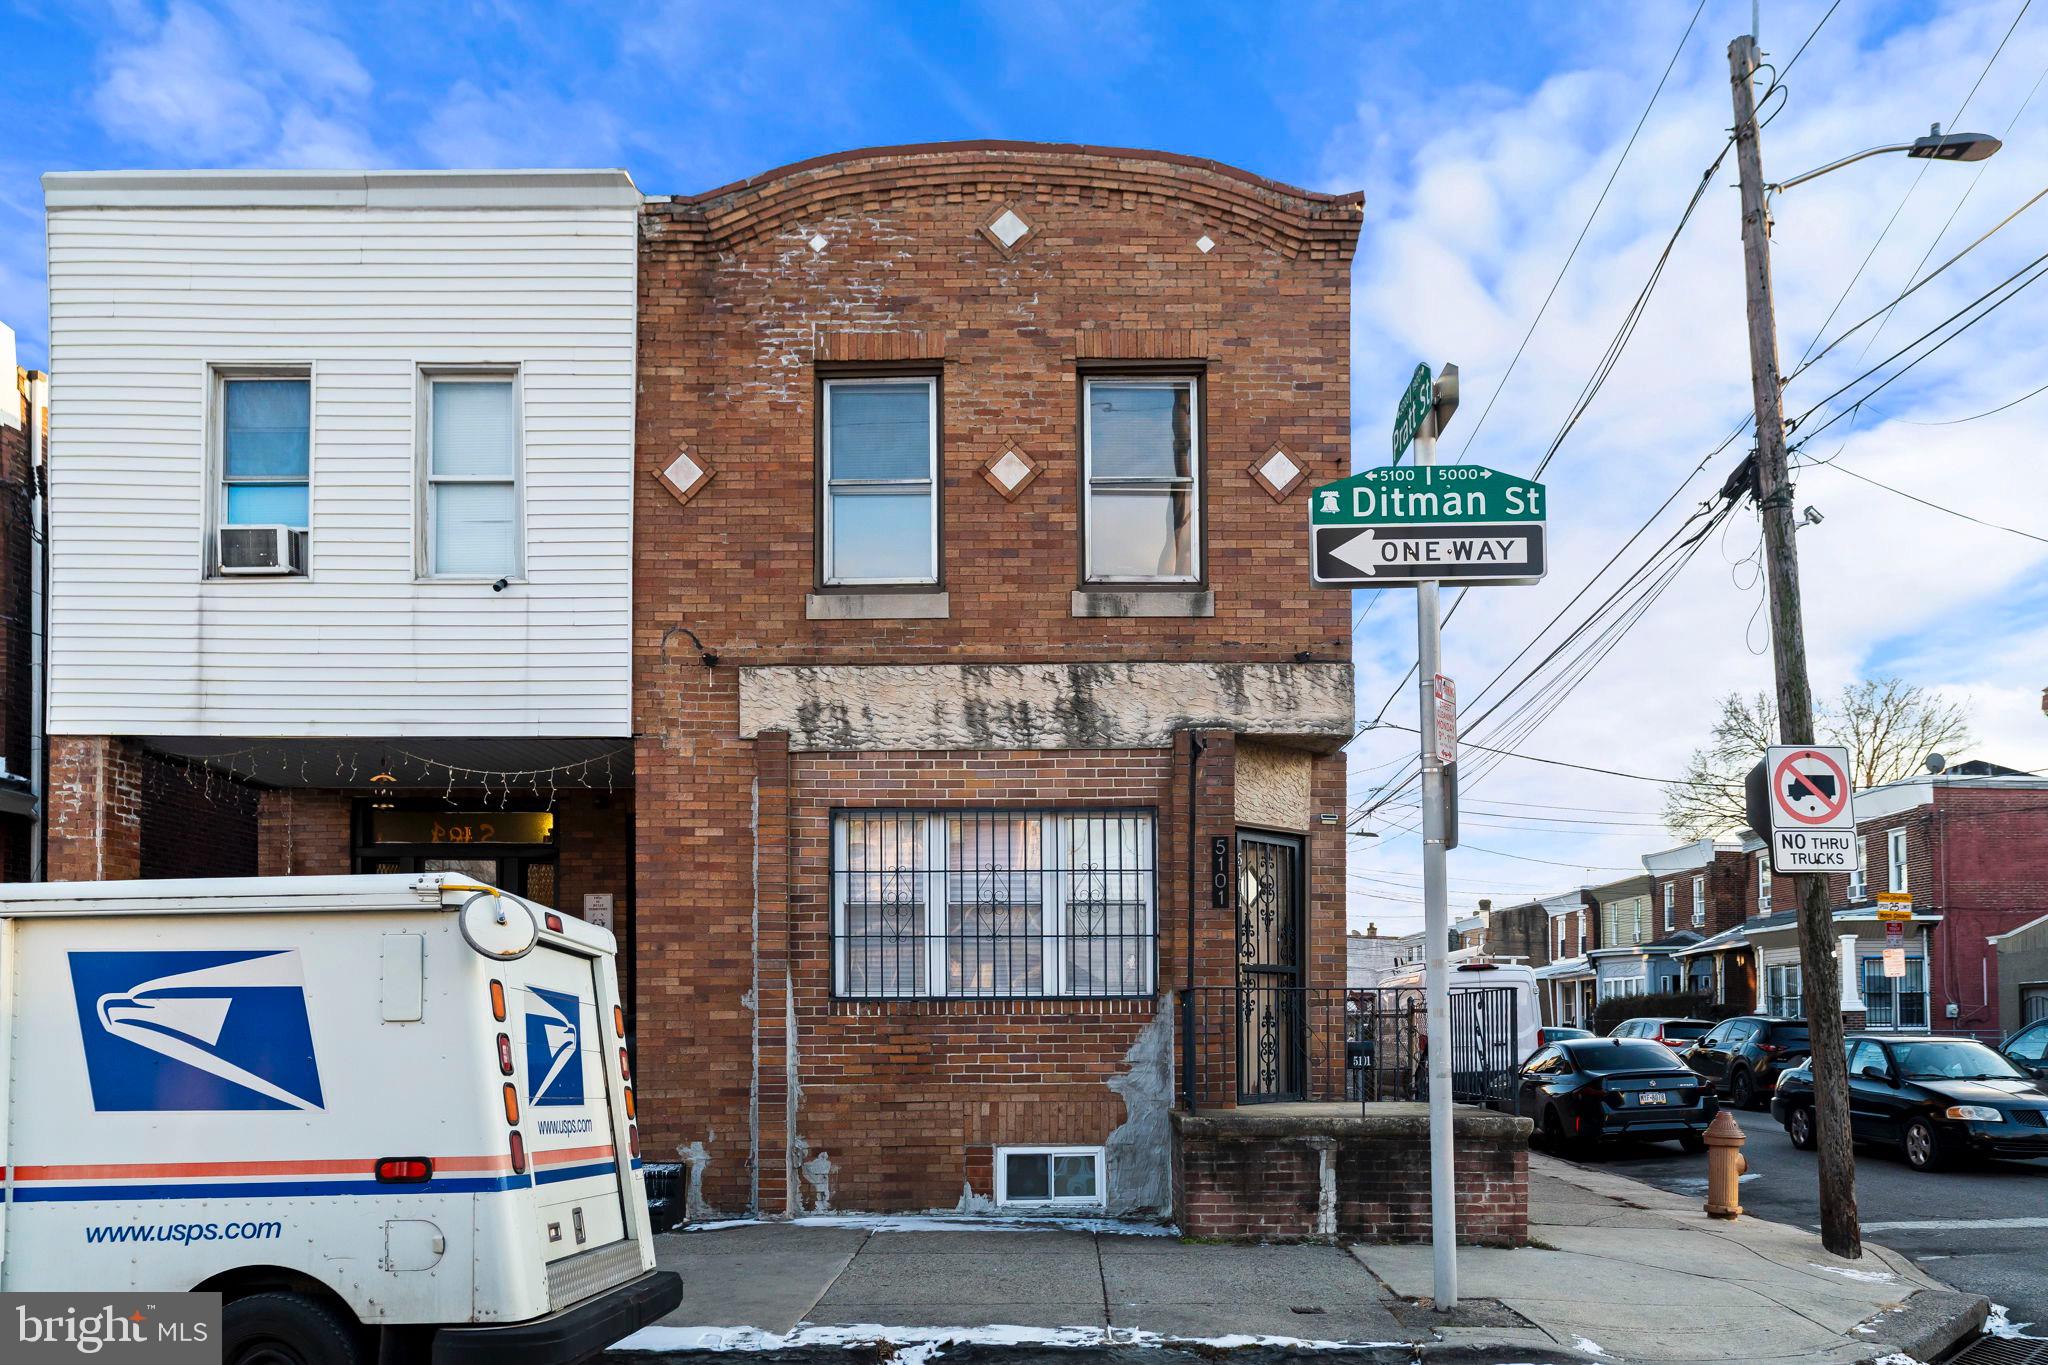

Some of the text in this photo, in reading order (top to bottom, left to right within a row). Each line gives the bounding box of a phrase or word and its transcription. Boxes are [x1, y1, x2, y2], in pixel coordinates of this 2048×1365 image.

[1393, 401, 1416, 460] Pratt
[1420, 378, 1430, 416] St
[1380, 468, 1478, 481] 5100 5000
[1352, 486, 1539, 517] Ditman St
[1381, 540, 1515, 562] ONE WAY
[1782, 833, 1849, 850] NO THRU
[1790, 853, 1844, 865] TRUCKS
[1215, 839, 1227, 905] 5101
[1889, 902, 1900, 912] 25
[537, 1118, 593, 1137] www.usps.com
[85, 1220, 282, 1248] www.usps.com
